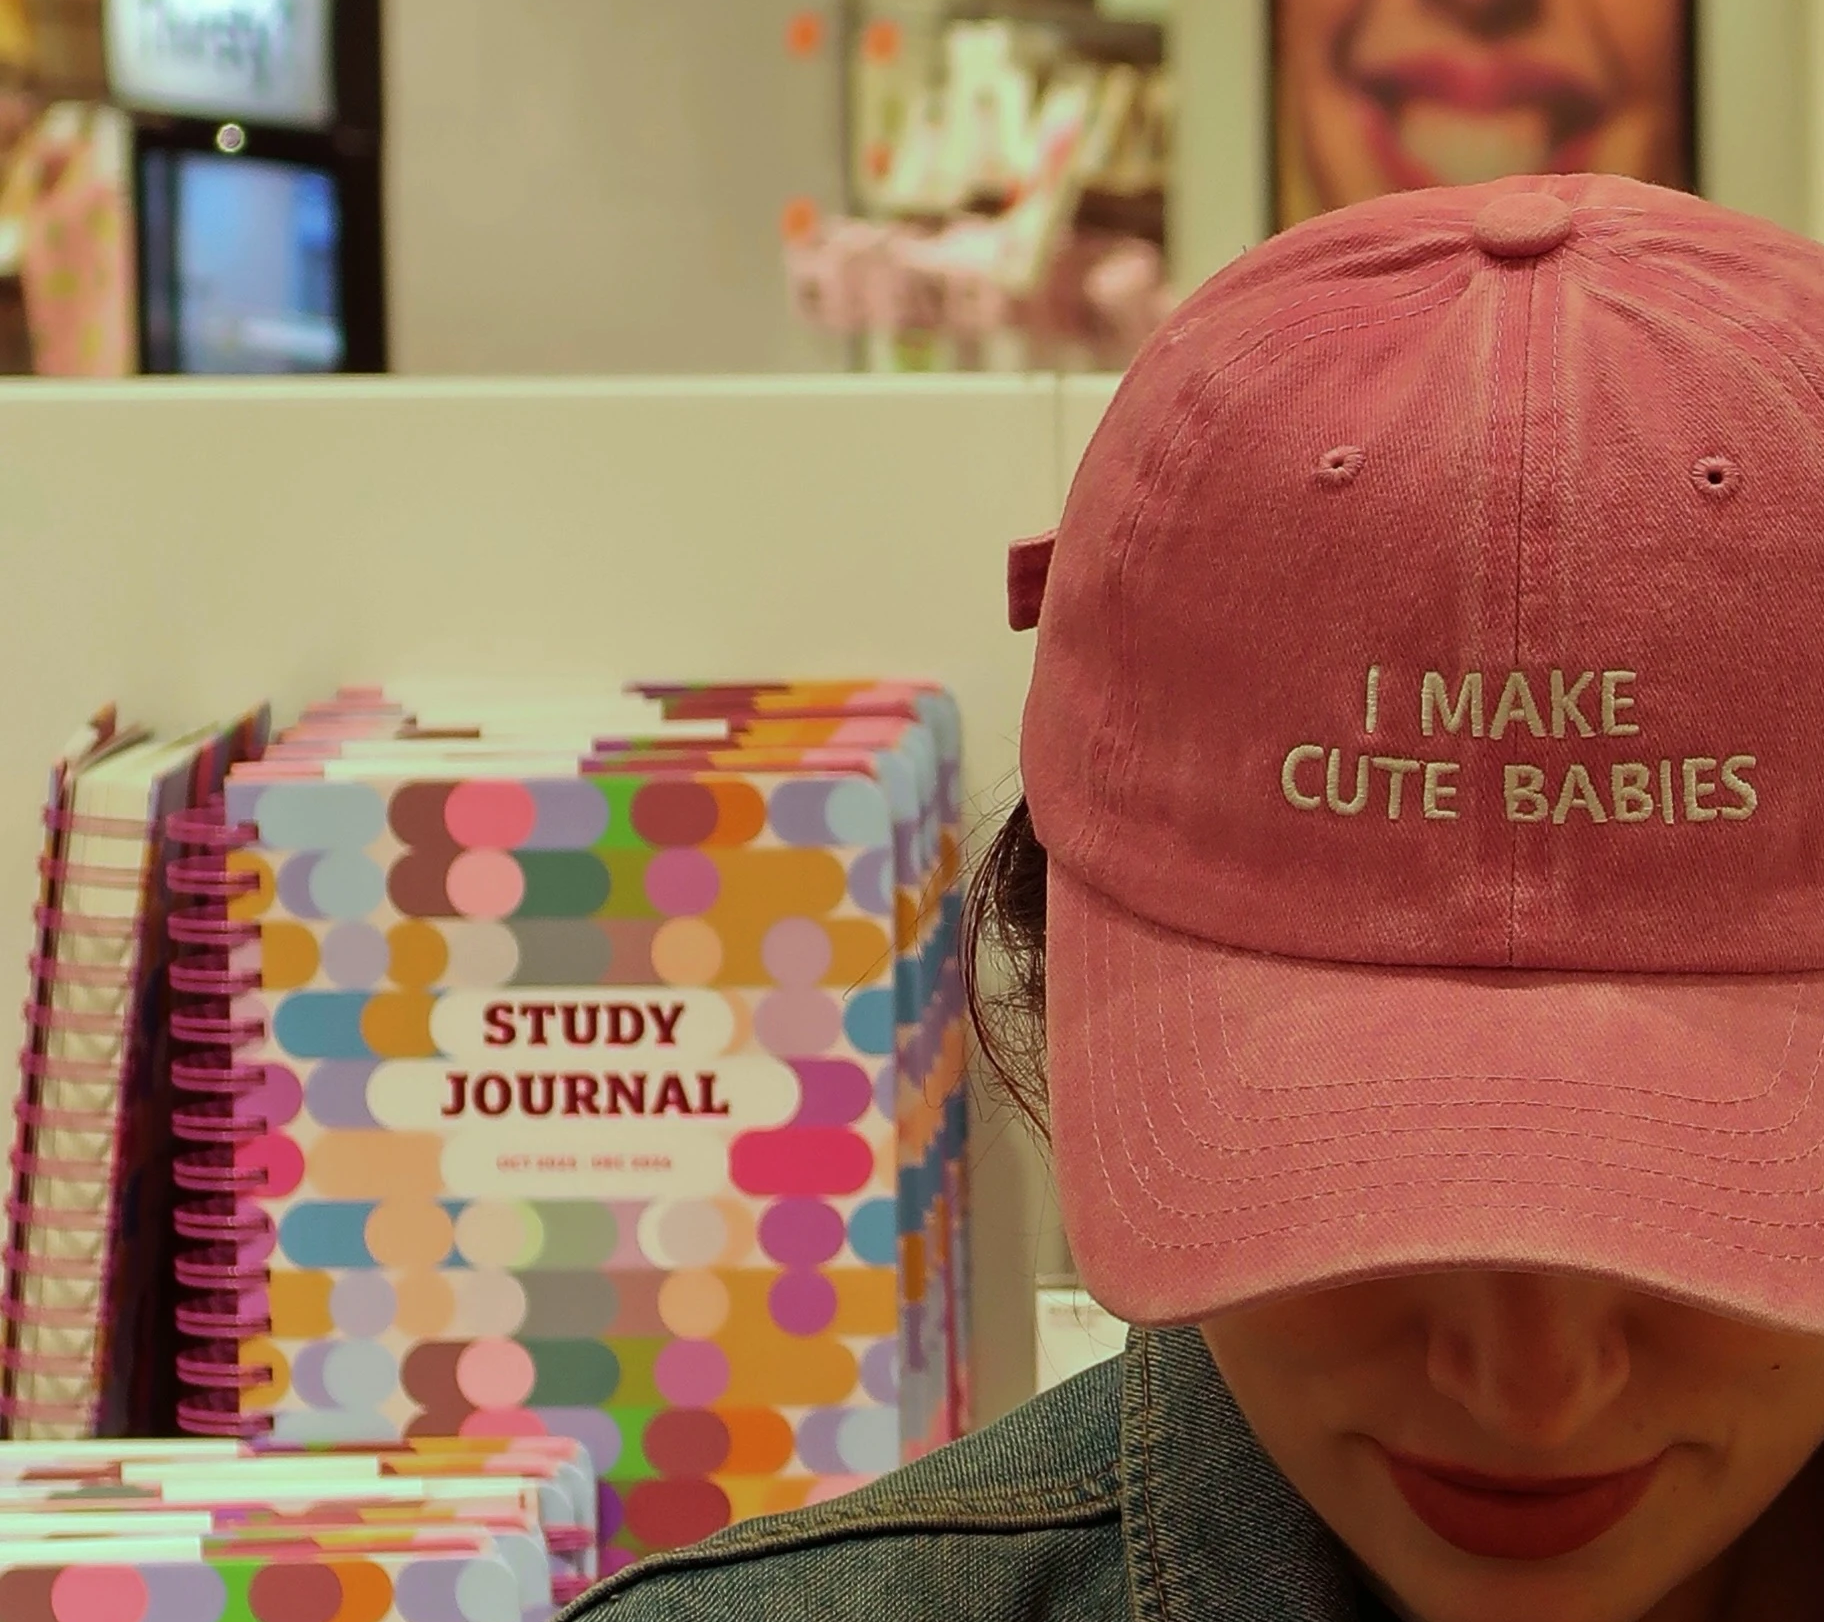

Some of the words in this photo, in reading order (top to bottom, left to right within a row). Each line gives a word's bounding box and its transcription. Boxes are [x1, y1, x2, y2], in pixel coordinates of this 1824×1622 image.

[1365, 665, 1380, 734] I
[1421, 668, 1640, 740] MAKE
[1281, 744, 1460, 821] CUTE
[1503, 755, 1758, 826] BABIES
[483, 1001, 685, 1047] STUDY
[441, 1072, 730, 1117] JOURNAL
